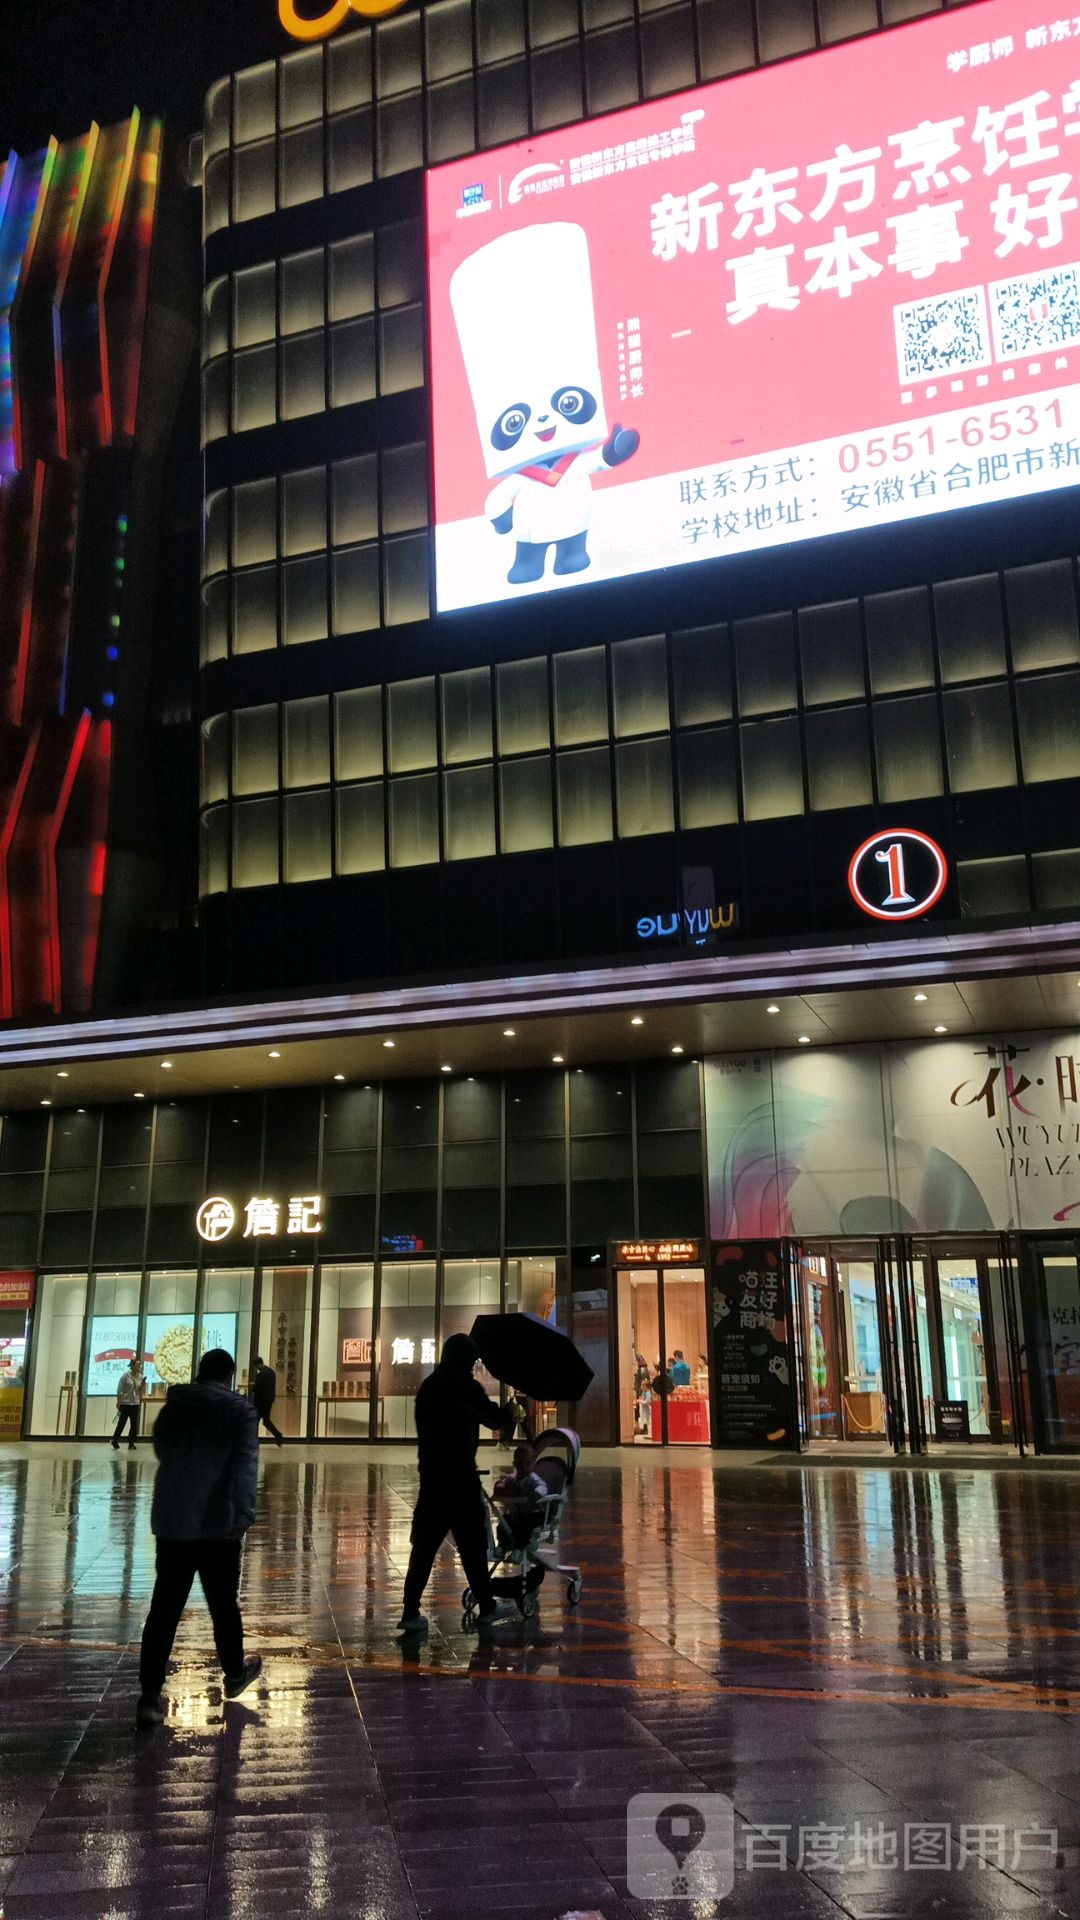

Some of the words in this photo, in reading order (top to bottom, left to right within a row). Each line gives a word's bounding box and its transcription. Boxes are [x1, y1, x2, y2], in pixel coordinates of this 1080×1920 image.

[649, 80, 1080, 261] 新东方烹饪
[725, 199, 970, 326] 真本事
[838, 398, 1063, 474] 0551-6531
[1009, 1154, 1080, 1178] PLAZ
[242, 1196, 321, 1238] 詹記
